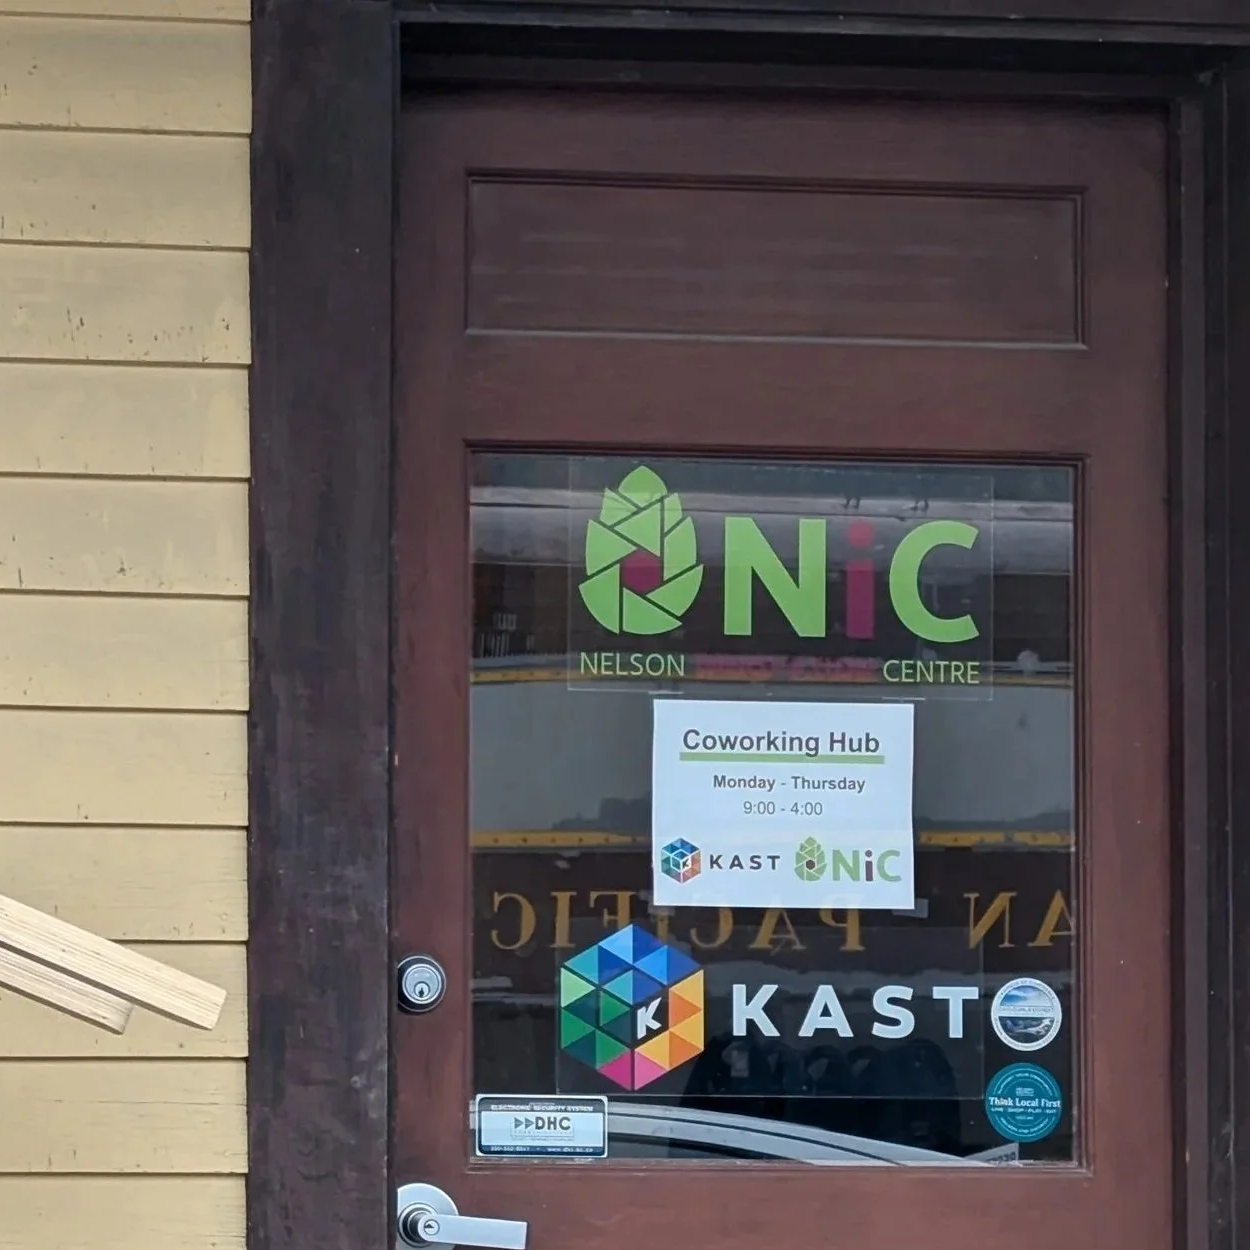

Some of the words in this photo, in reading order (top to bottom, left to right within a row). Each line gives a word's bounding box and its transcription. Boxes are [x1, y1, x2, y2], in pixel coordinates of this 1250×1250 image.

[579, 652, 686, 677] NELSON
[882, 659, 981, 685] CENTRE
[682, 728, 820, 758] Coworking
[829, 731, 880, 754] Hub
[713, 774, 776, 793] Monday
[790, 776, 866, 794] Thursday
[742, 800, 776, 816] 9:00
[790, 801, 823, 816] 4:00
[709, 854, 782, 871] KAST
[831, 849, 903, 883] NiC
[636, 996, 664, 1040] K
[731, 983, 979, 1040] KAST
[989, 1096, 1014, 1106] Think
[1015, 1097, 1039, 1107] Local
[1041, 1098, 1061, 1108] First
[534, 1116, 572, 1131] DHC
